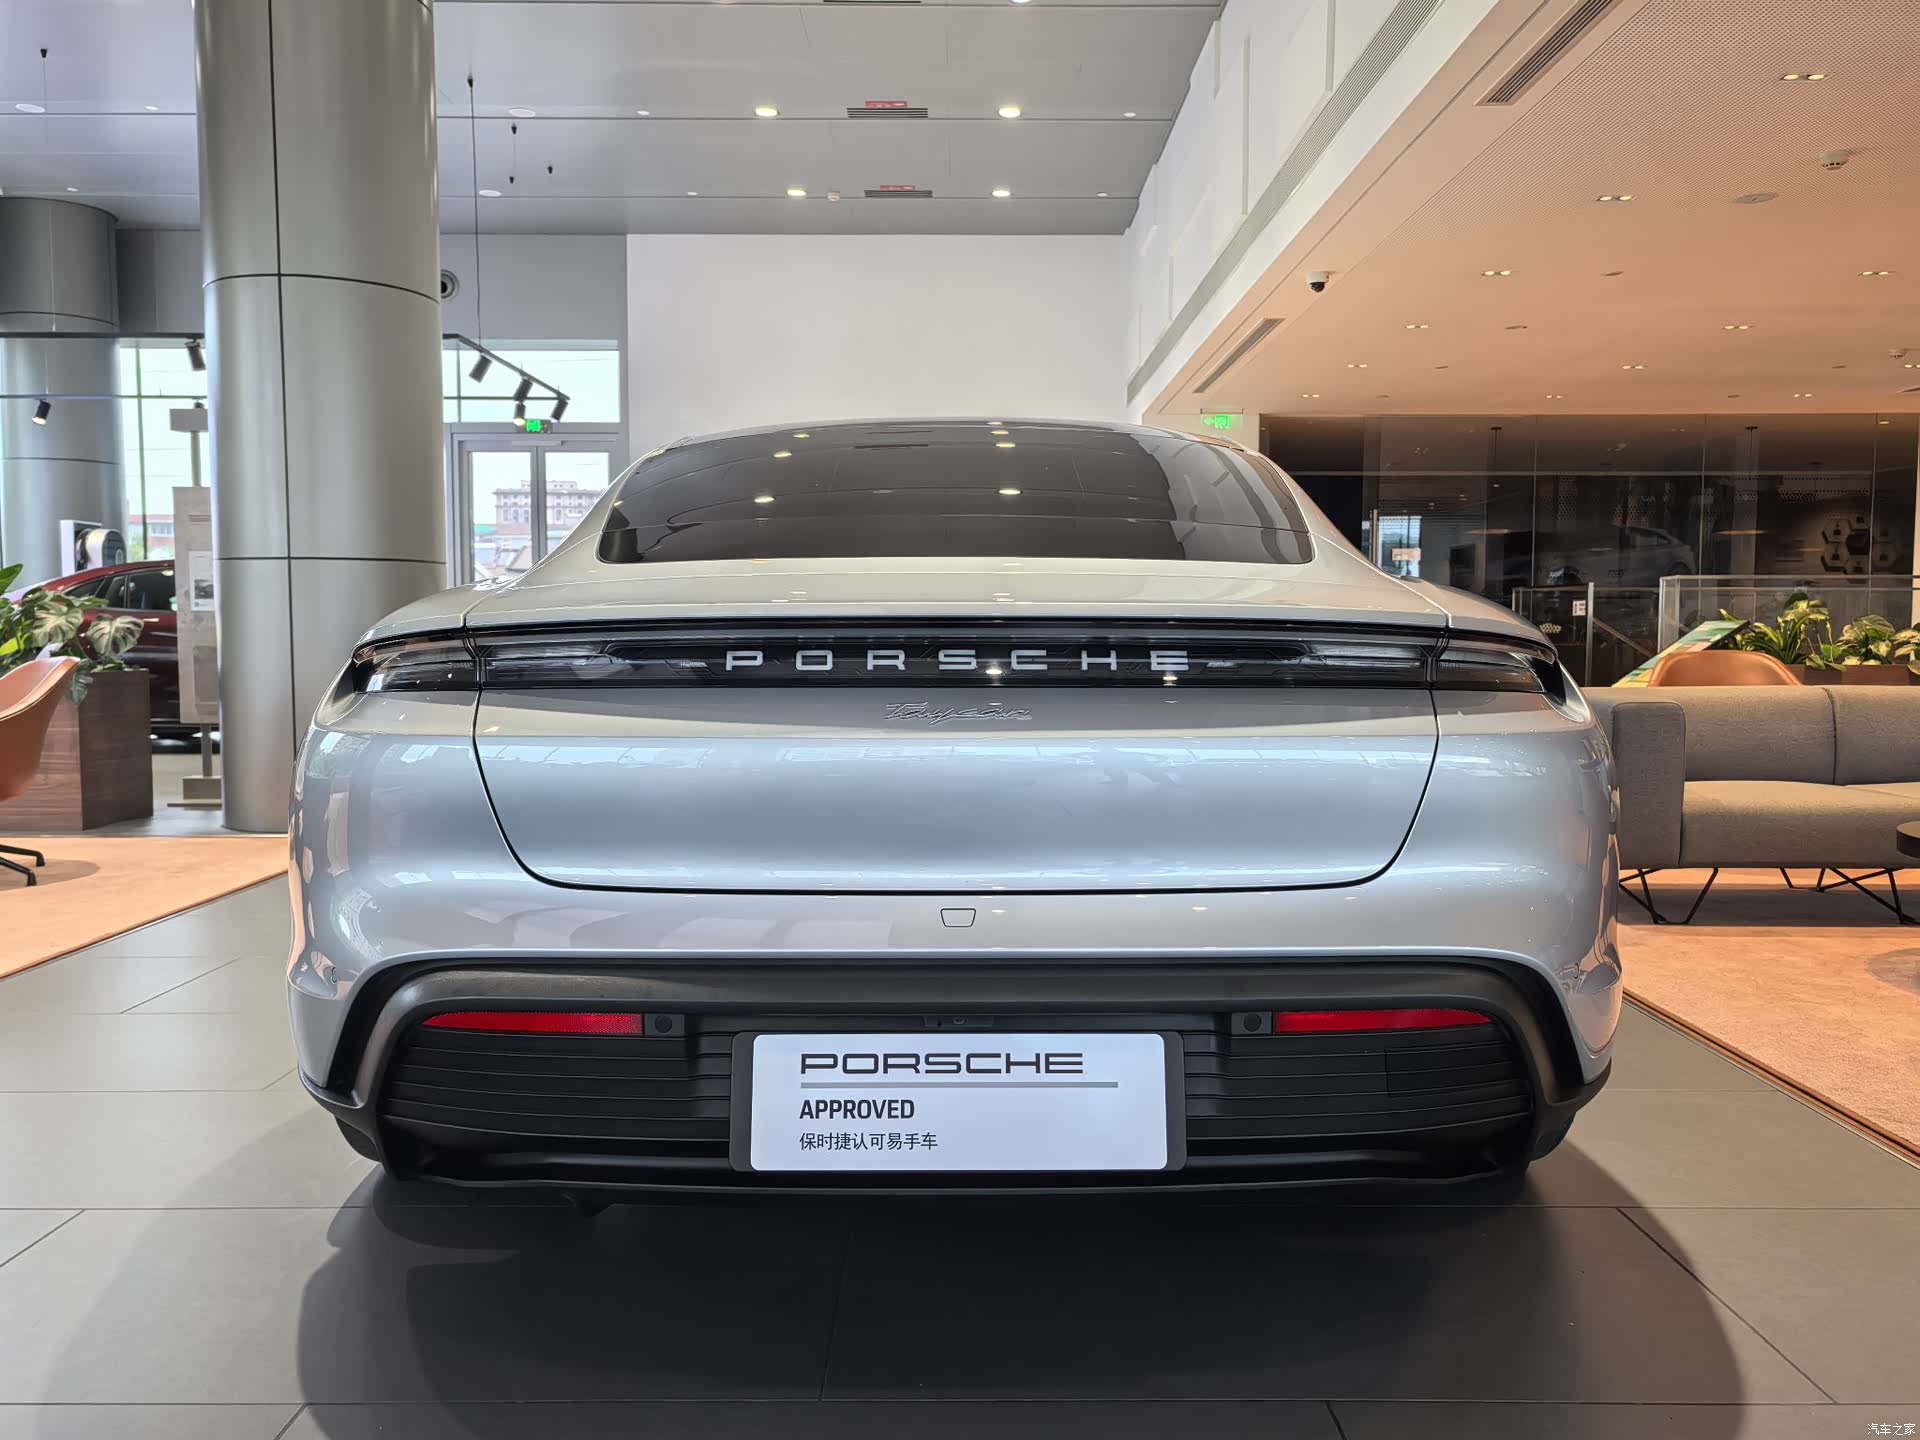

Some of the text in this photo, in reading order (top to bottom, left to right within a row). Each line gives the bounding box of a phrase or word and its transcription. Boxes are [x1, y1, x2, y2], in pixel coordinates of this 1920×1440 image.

[725, 650, 1189, 671] PORSCHE
[884, 701, 1033, 727] Taycan
[800, 1052, 1084, 1075] PORSCHE
[799, 1099, 915, 1120] APPROVED
[799, 1131, 939, 1151] 保时捷认可易手车
